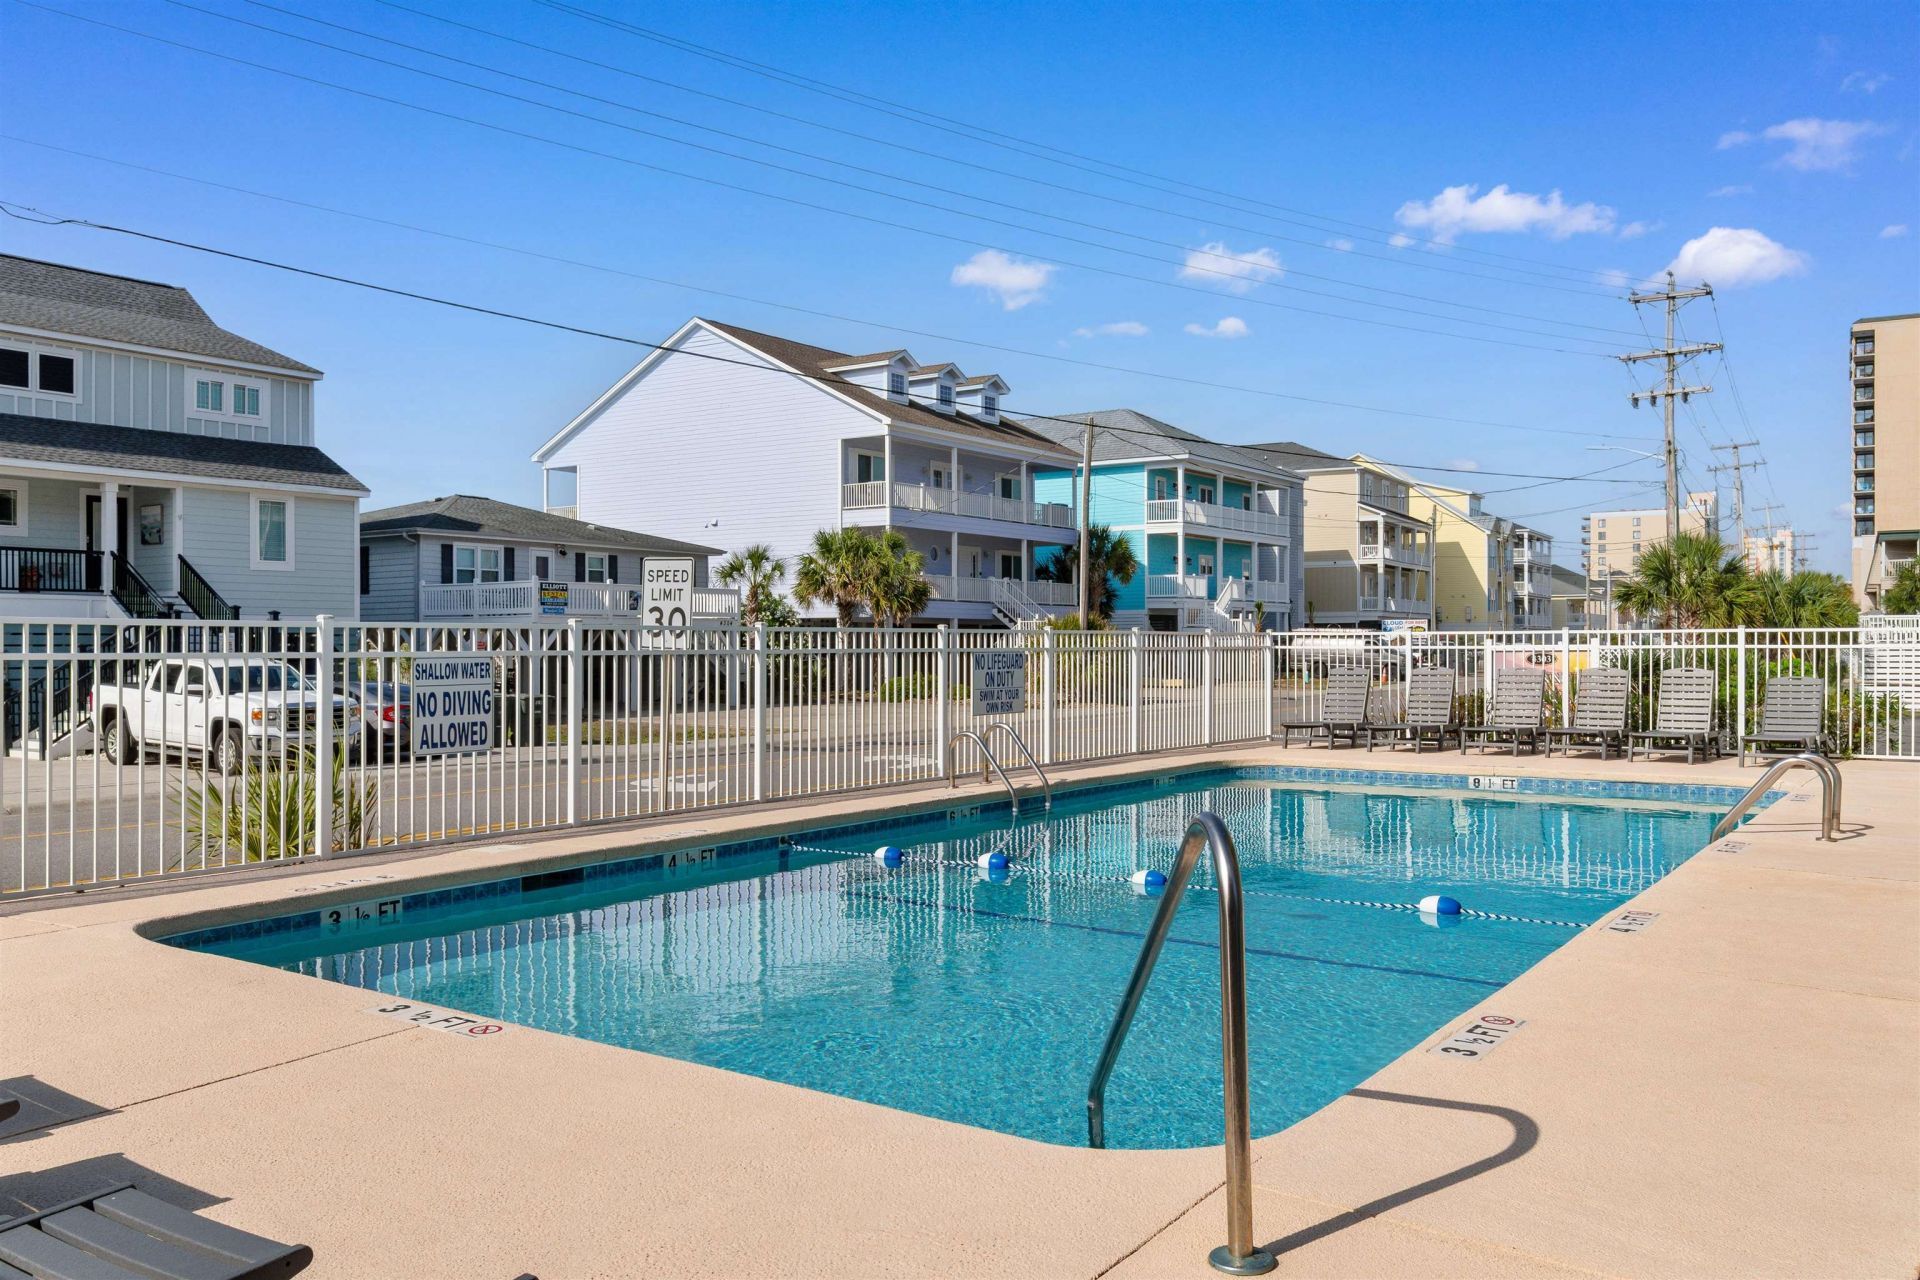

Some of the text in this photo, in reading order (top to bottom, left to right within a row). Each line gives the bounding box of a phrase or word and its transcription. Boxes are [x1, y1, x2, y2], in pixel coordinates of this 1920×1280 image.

[647, 570, 689, 583] SPEED
[651, 588, 684, 602] LIMIT
[647, 606, 687, 639] 30
[974, 653, 1024, 671] NO LIFEGUARD
[415, 662, 491, 681] SHALLOW WATER
[985, 670, 1015, 688] ON DUTY
[416, 689, 491, 718] NO DIVING
[980, 688, 1020, 702] SWIM AT YOUR
[985, 701, 1014, 714] OWN RISK
[420, 721, 488, 750] ALLOWED
[700, 848, 715, 862] FT
[378, 900, 401, 917] FT
[378, 1004, 411, 1013] 3
[428, 1016, 478, 1029] FT
[1440, 1046, 1478, 1057] 3
[1465, 1024, 1509, 1039] FT
